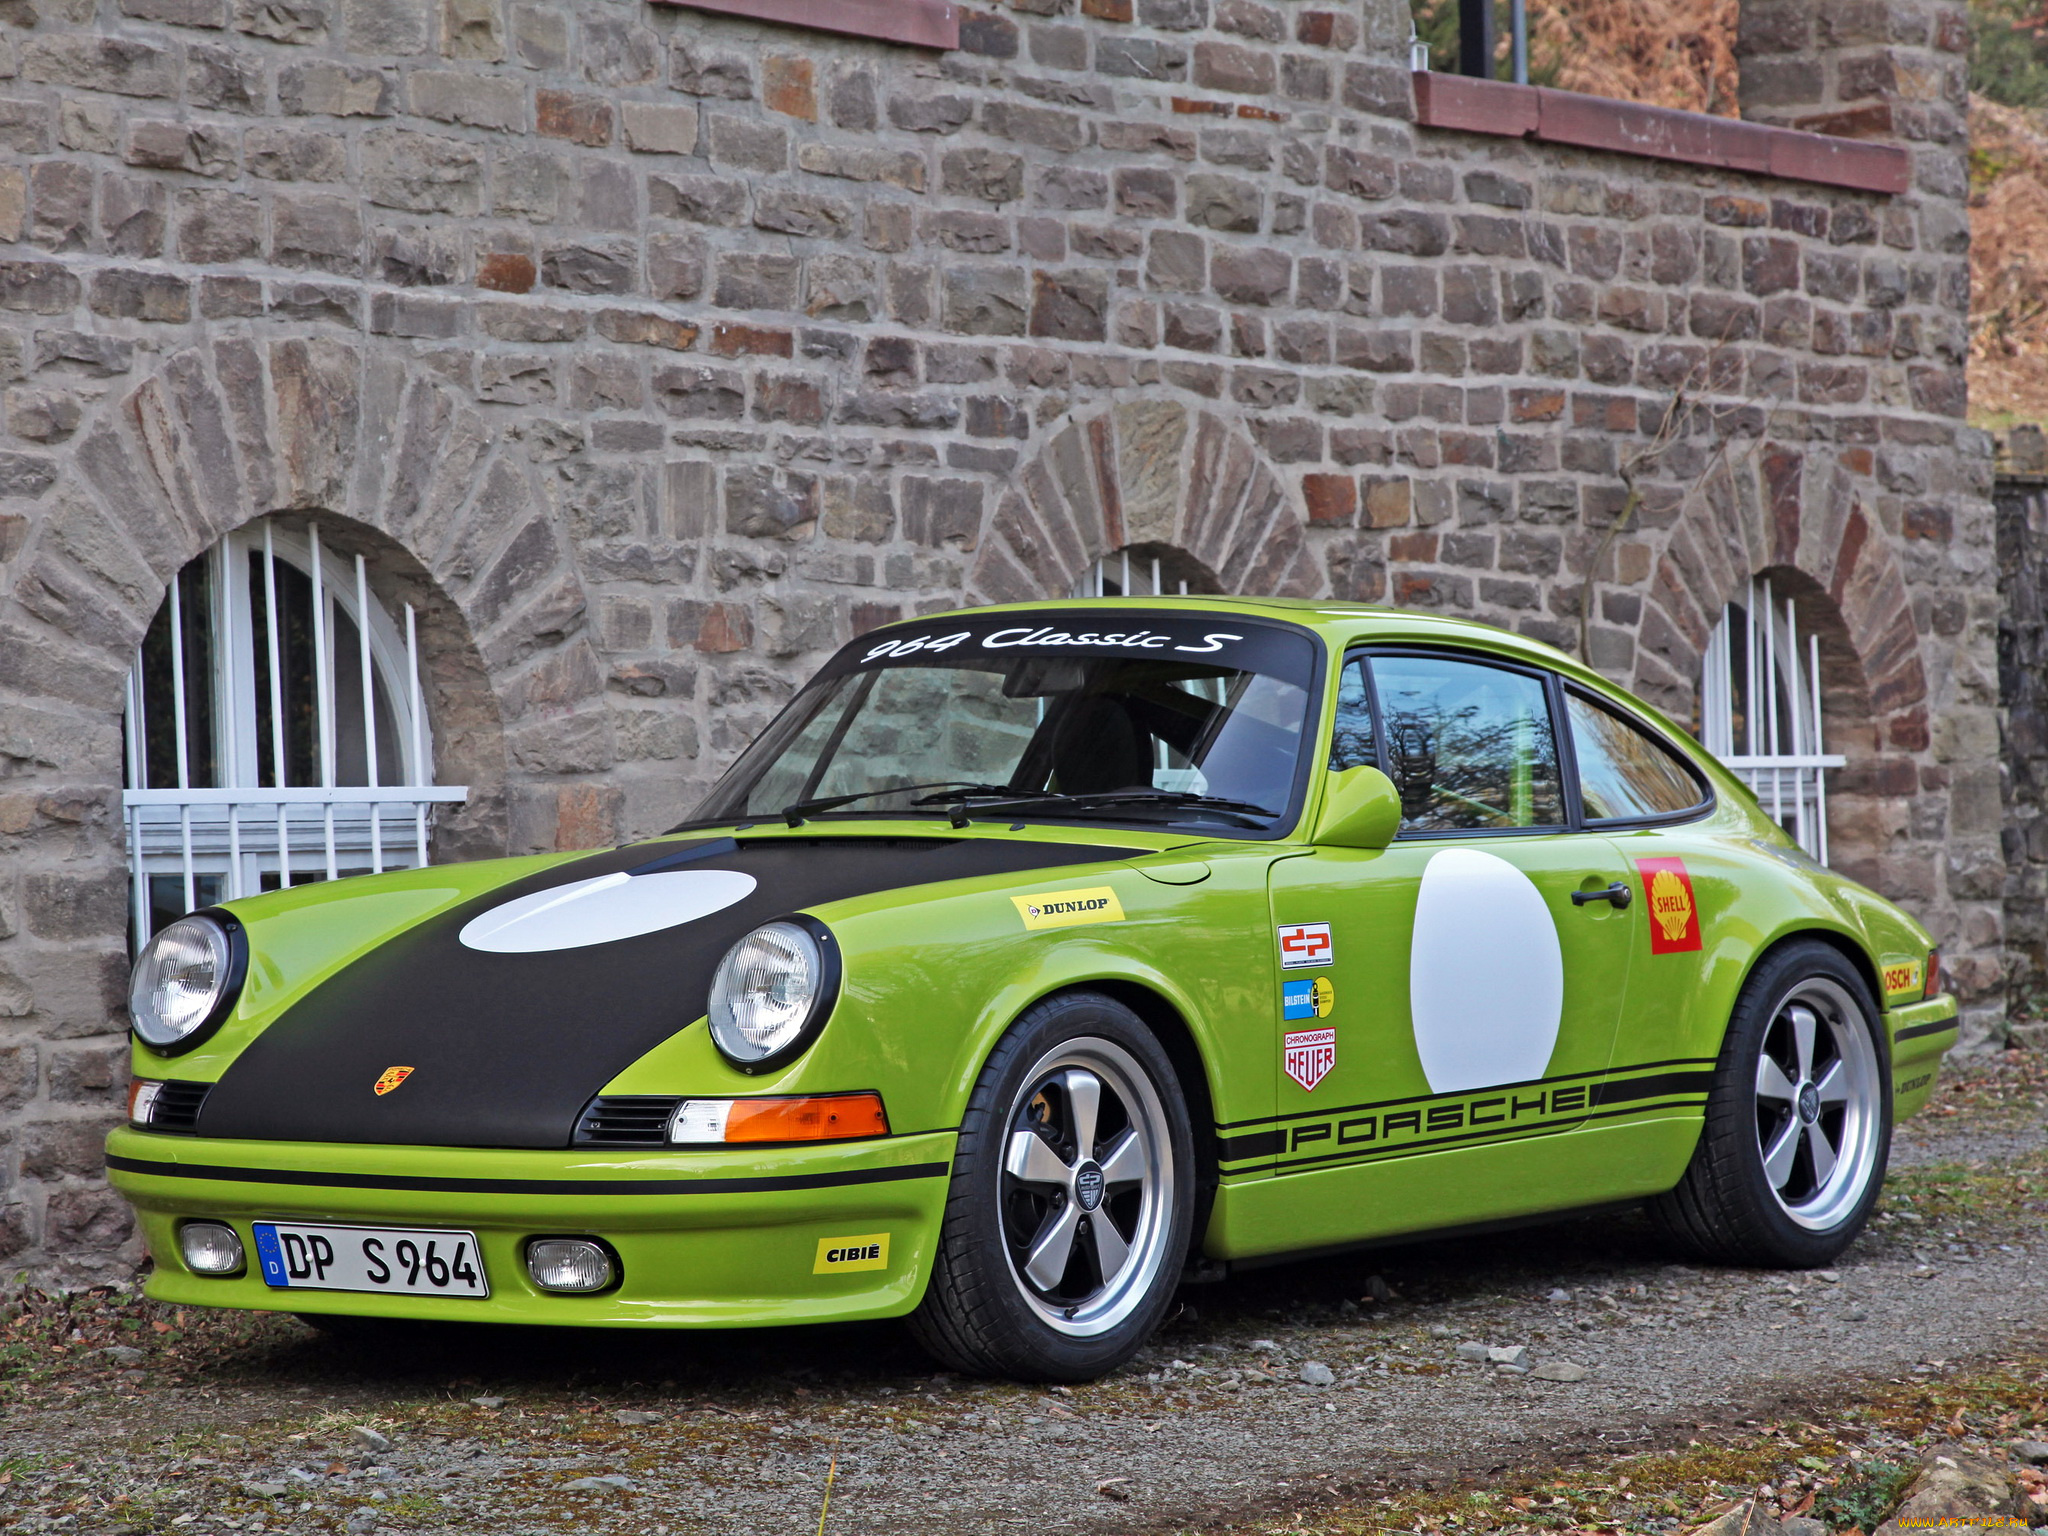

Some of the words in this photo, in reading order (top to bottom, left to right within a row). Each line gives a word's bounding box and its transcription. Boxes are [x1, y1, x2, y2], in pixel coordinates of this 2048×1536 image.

[860, 631, 972, 664] 964
[981, 626, 1171, 649] Classic
[1174, 632, 1244, 653] S
[1043, 898, 1108, 915] DUNLOP
[1657, 895, 1686, 913] SHELL
[1284, 993, 1311, 1007] BILSTEIN
[1286, 1031, 1334, 1045] CHRONOGRAPH
[1288, 1047, 1334, 1087] HEUER
[1291, 1085, 1587, 1152] PORSCHE
[280, 1232, 334, 1281] DP
[826, 1243, 880, 1263] CIBIÉ
[268, 1261, 279, 1275] D
